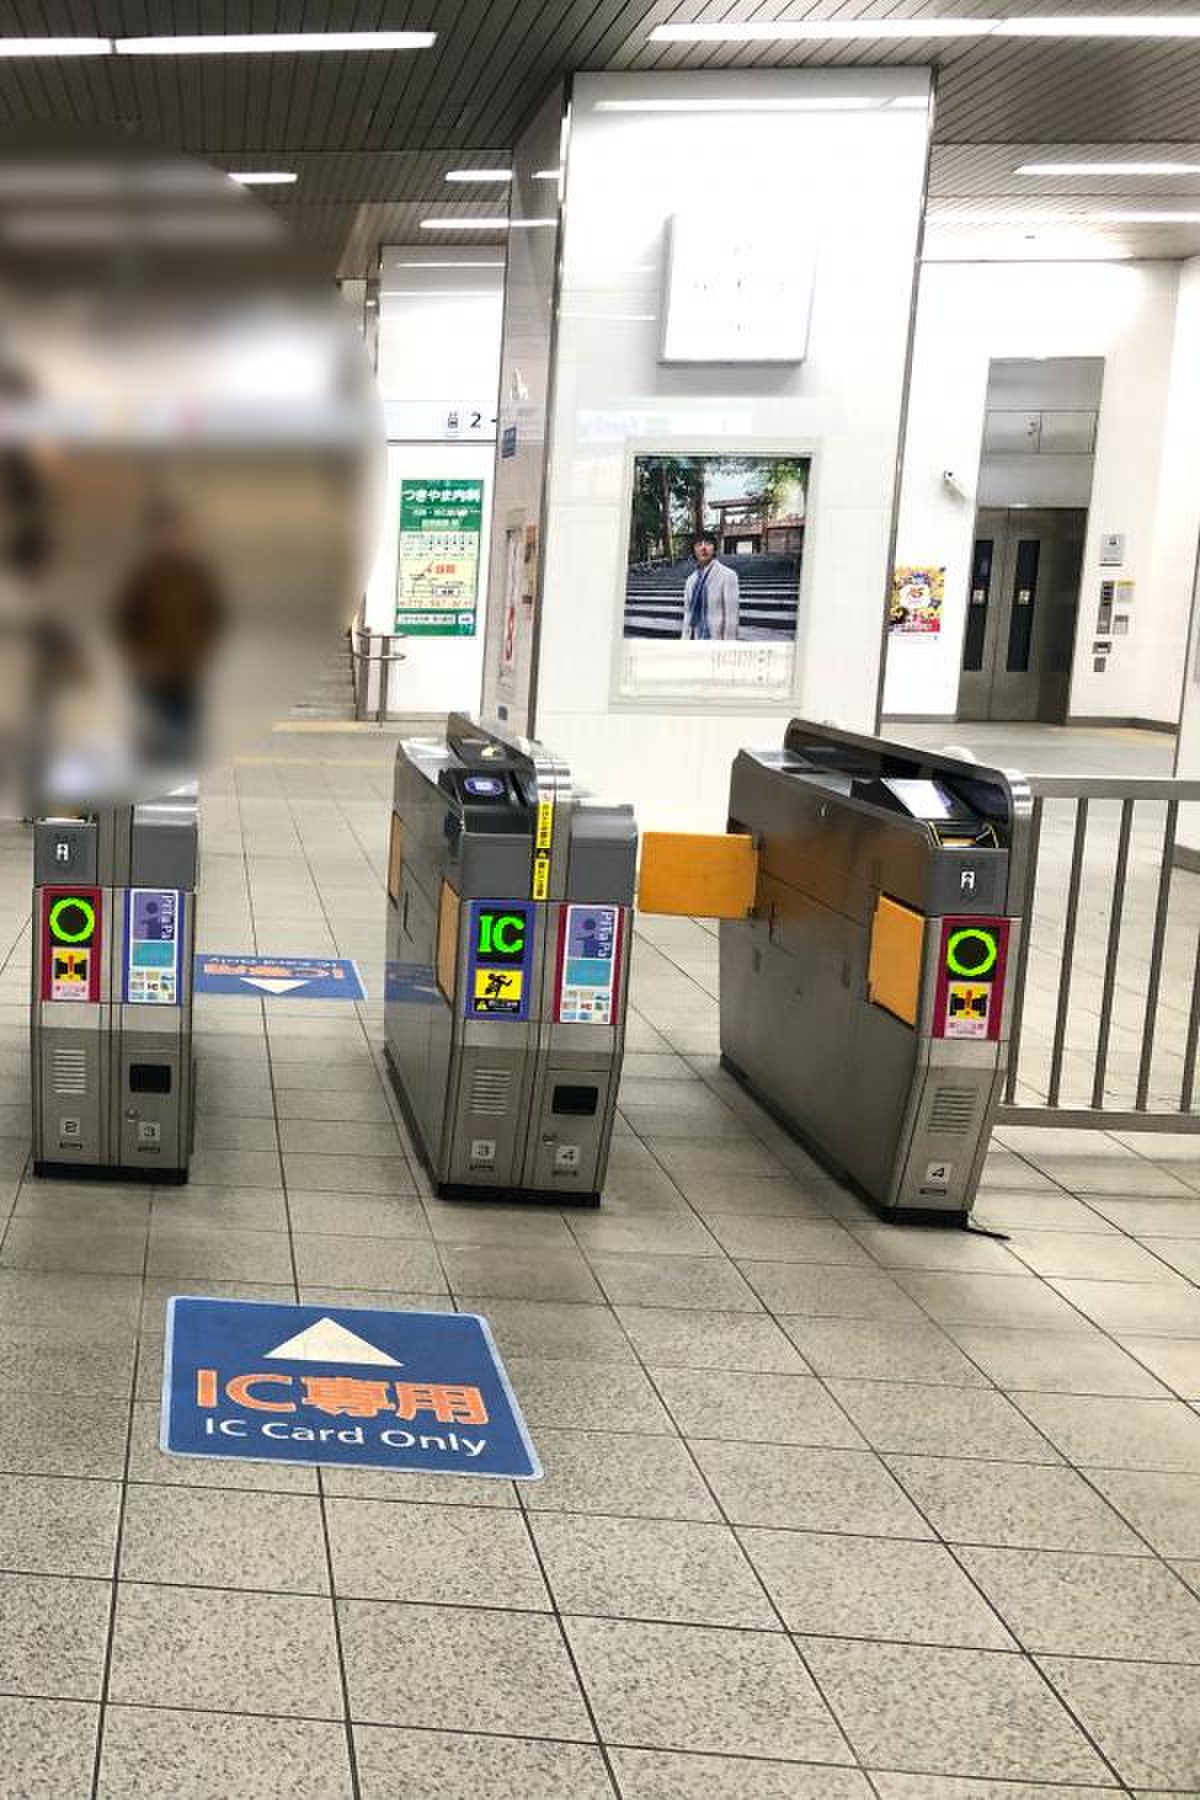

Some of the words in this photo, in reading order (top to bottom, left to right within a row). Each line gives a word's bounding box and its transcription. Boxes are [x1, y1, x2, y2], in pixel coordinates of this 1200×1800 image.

[477, 914, 525, 953] IC
[195, 1368, 489, 1425] IC専用
[205, 1417, 247, 1437] IC
[261, 1422, 366, 1446] Card
[380, 1430, 488, 1457] Only
